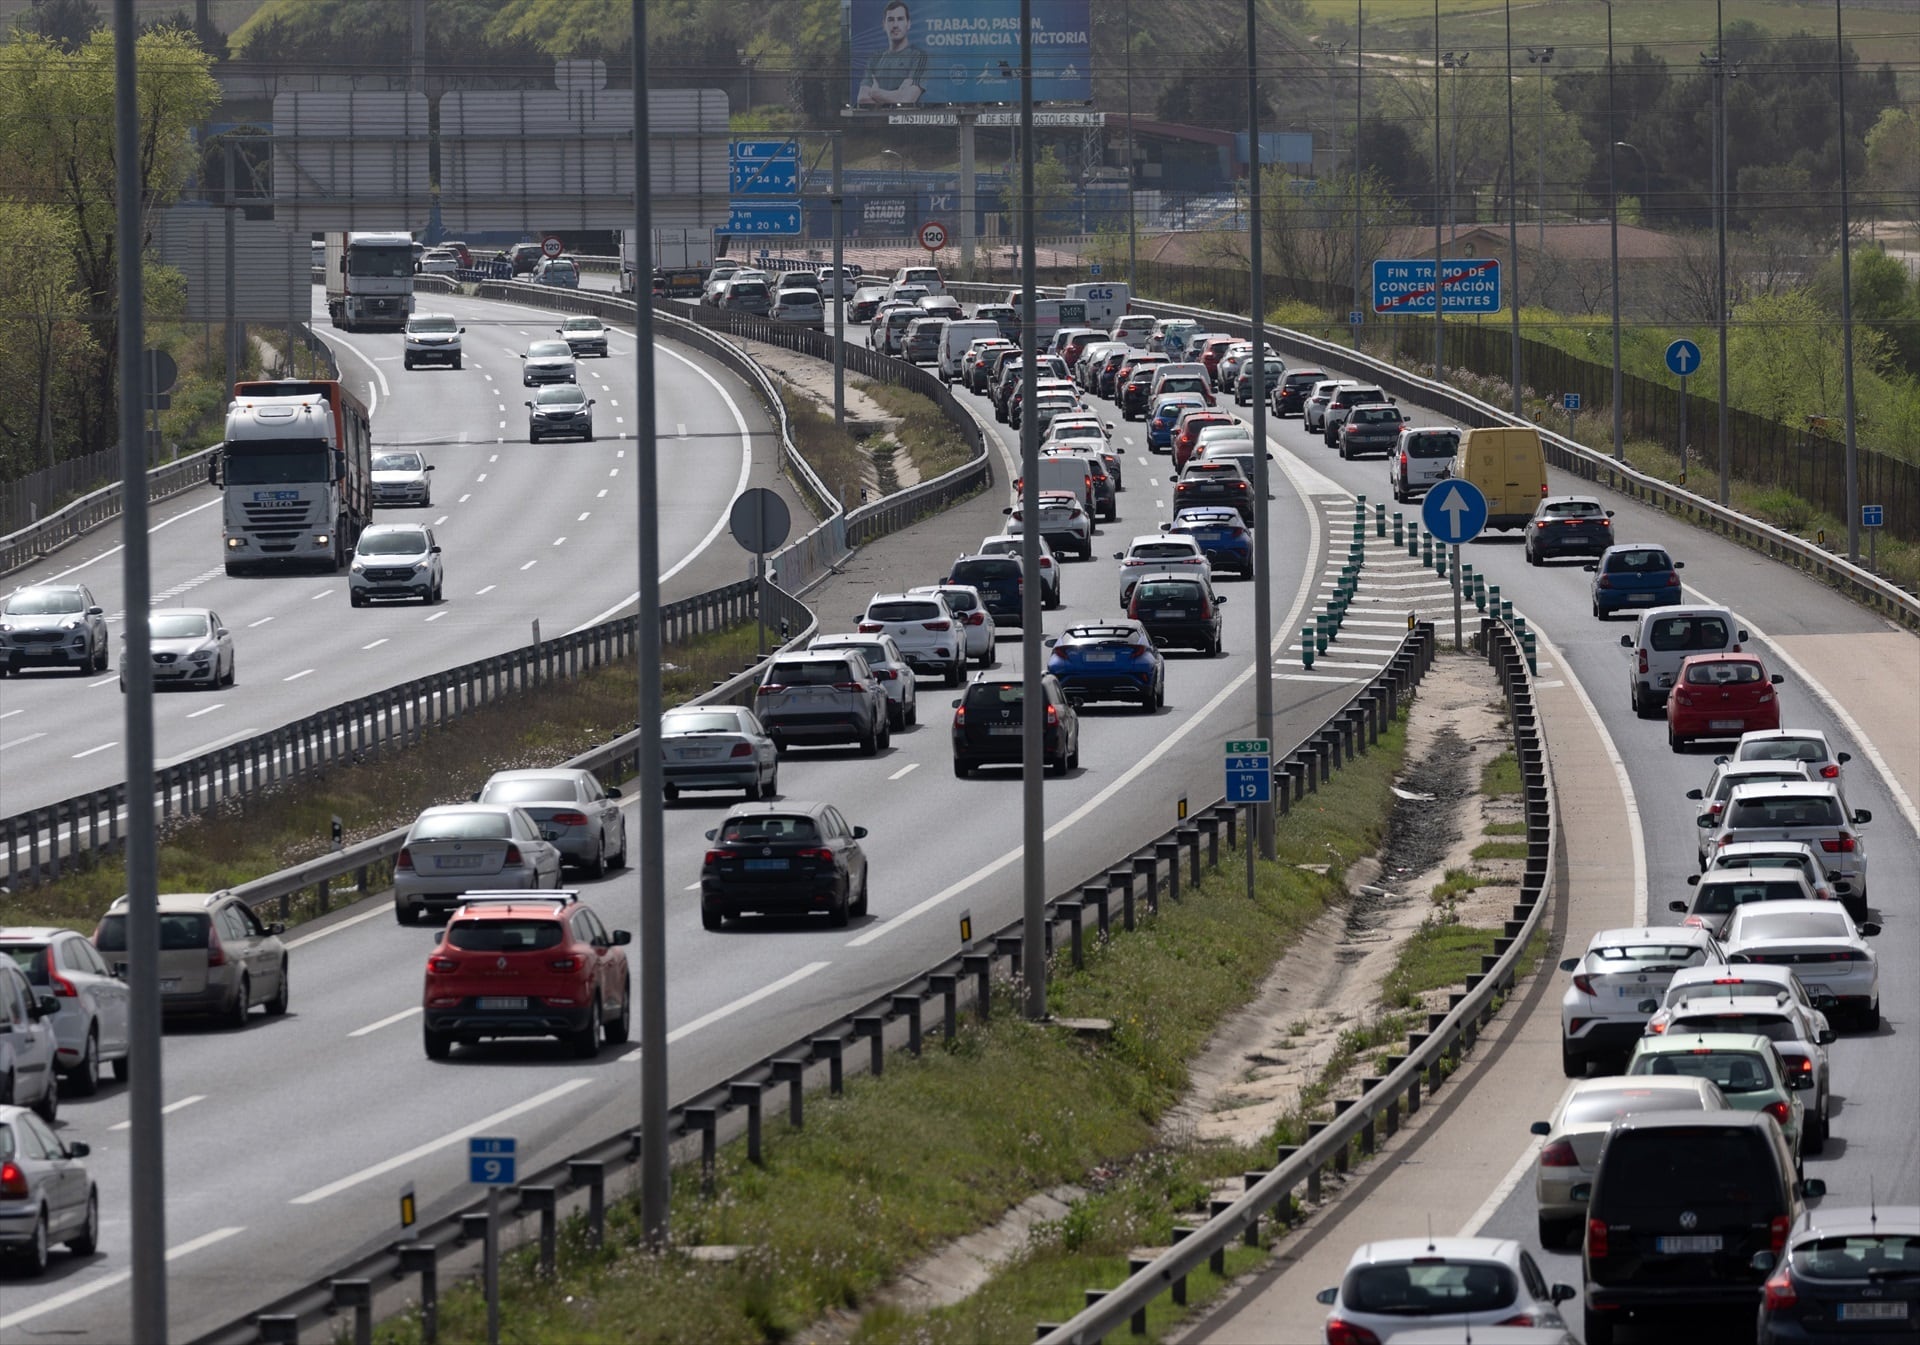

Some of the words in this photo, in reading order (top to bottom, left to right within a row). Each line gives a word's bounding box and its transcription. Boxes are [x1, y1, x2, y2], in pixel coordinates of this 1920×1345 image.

[925, 18, 990, 31] TRABAJO,
[992, 17, 1044, 31] PASIN,
[925, 32, 1012, 46] CONSTANCIA
[756, 175, 770, 184] 24
[737, 210, 752, 219] km
[863, 205, 906, 219] ESTADIO
[756, 221, 770, 230] 20
[924, 231, 943, 242] 120
[545, 243, 560, 251] 120
[1387, 267, 1408, 278] FIN
[1415, 267, 1462, 278] TRMO
[1469, 267, 1486, 277] DE
[1379, 279, 1495, 292] CONCENRACIÓN
[1088, 288, 1113, 300] GLS
[1383, 296, 1400, 306] DE
[1408, 295, 1491, 306] ACCDENTES
[1568, 400, 1576, 408] 2
[260, 500, 293, 509] IVECO
[1232, 742, 1261, 752] E-90
[1235, 758, 1259, 769] A-5
[1240, 774, 1254, 782] km
[1239, 784, 1257, 798] 19
[483, 1159, 502, 1180] 9
